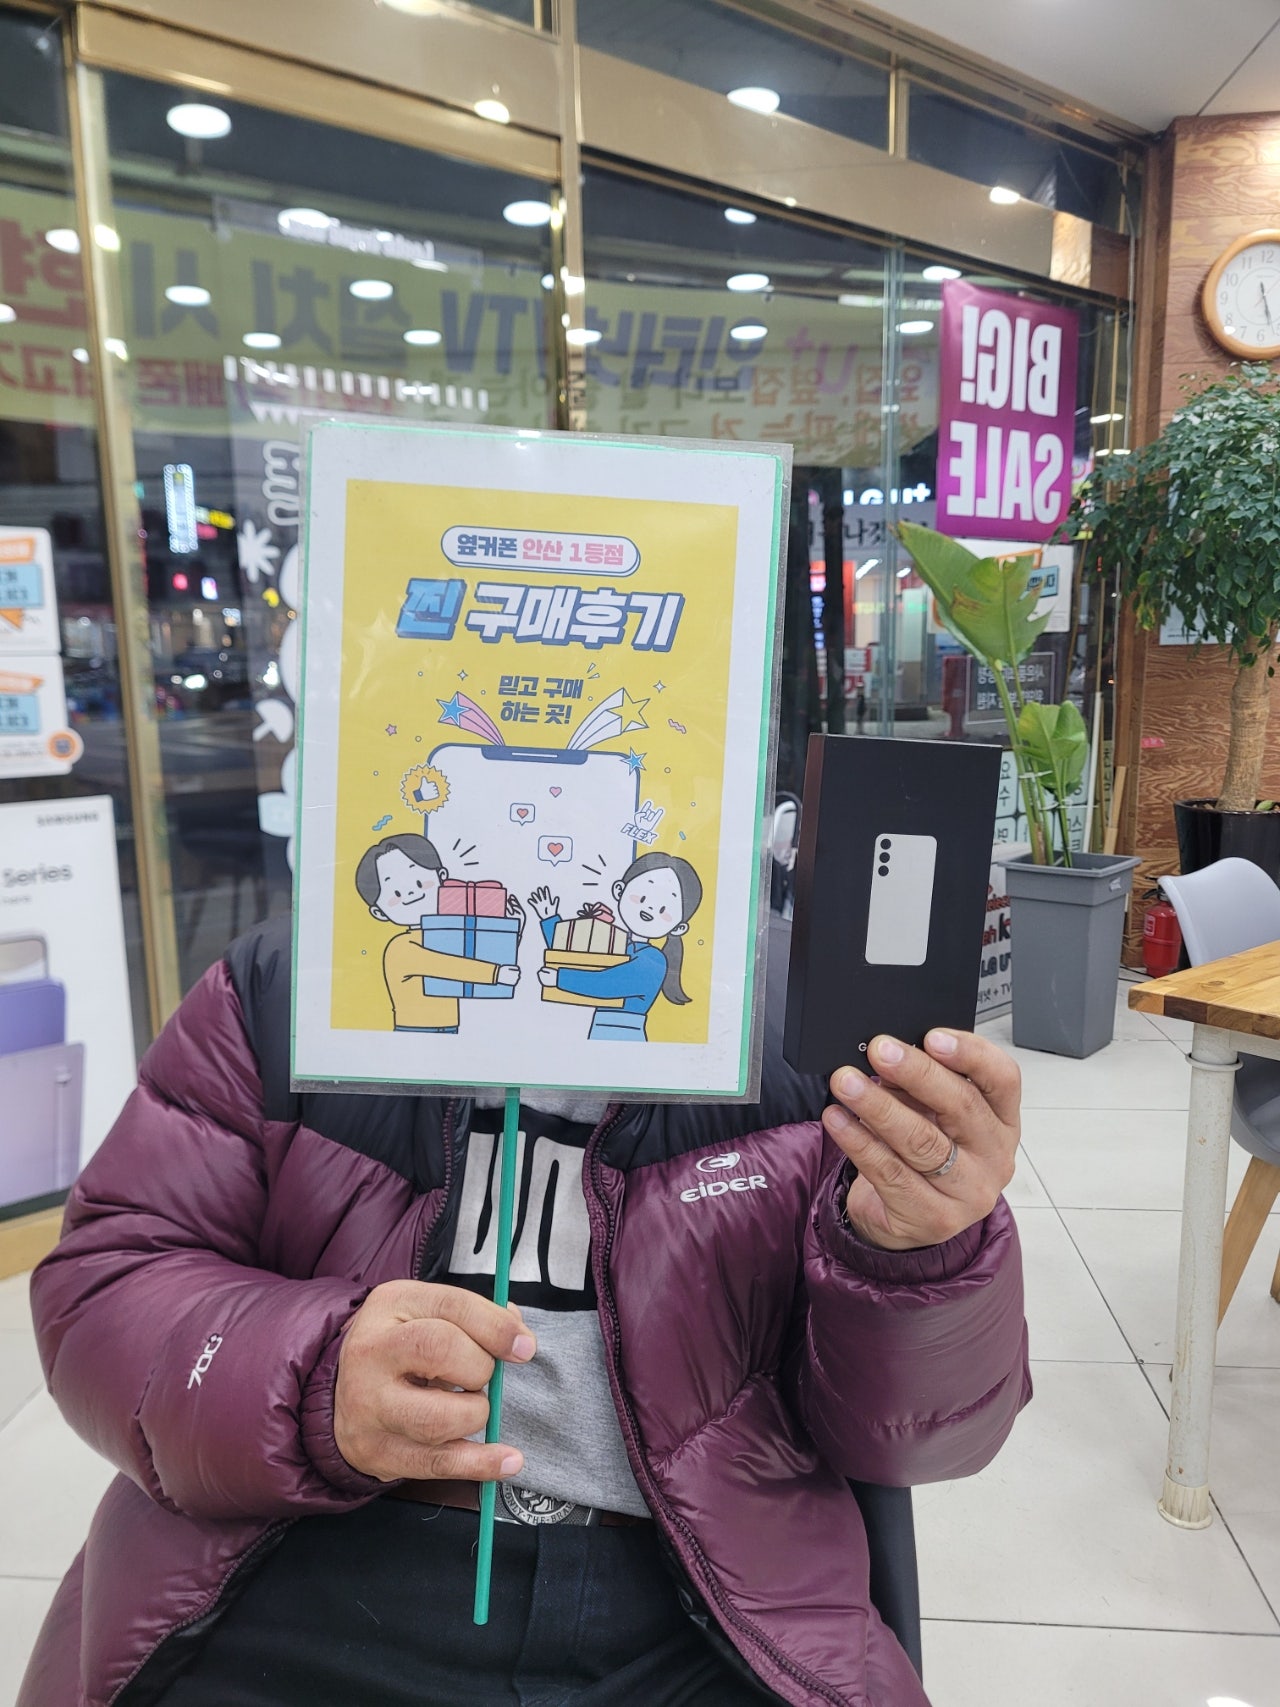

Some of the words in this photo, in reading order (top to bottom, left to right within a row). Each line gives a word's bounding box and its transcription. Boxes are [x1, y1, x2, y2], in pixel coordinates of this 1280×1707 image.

[457, 533, 518, 559] 옆커폰
[522, 538, 563, 562] 안산
[569, 542, 624, 566] 1등점
[396, 578, 467, 640] 찐
[466, 581, 686, 653] 구매후기
[498, 675, 539, 698] 믿고
[543, 677, 584, 699] 구매
[500, 701, 540, 724] 하는
[543, 703, 572, 725] 곳!
[620, 822, 658, 845] FLEX
[526, 1514, 546, 1525] THE
[551, 1501, 576, 1523] BRAV
